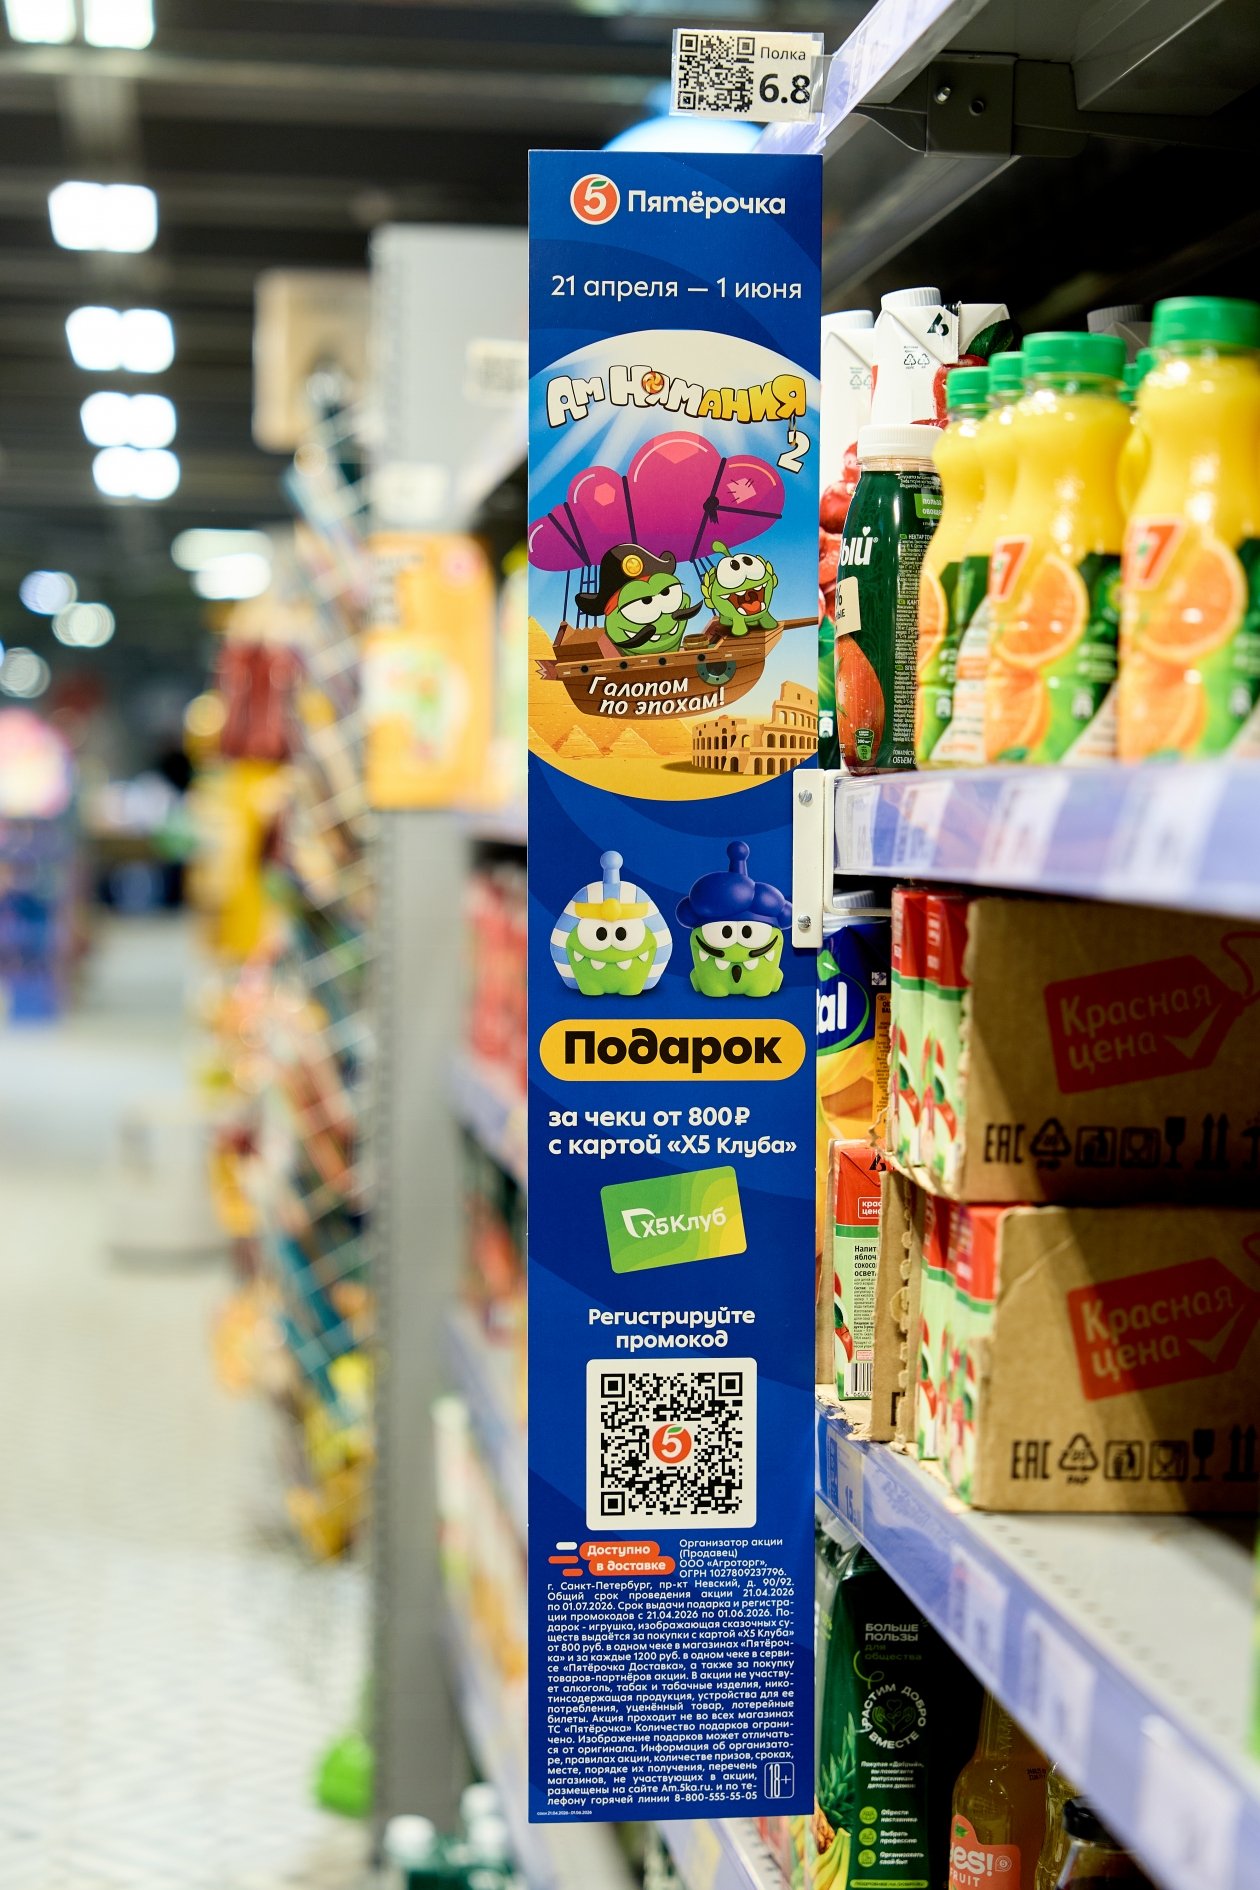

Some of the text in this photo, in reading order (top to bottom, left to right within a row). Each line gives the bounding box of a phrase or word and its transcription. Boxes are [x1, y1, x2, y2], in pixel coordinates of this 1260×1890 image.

[760, 46, 806, 62] Полка
[759, 73, 811, 105] 6.8
[628, 189, 786, 219] Пятёрочка
[551, 276, 575, 296] 21
[584, 277, 678, 301] апреля
[716, 277, 726, 298] 1
[734, 279, 802, 299] июня
[777, 429, 811, 475] 2
[589, 676, 688, 698] Галопом
[600, 687, 725, 715] по эпохам!
[1059, 983, 1213, 1038] Красная
[564, 1027, 782, 1074] Подарок
[1068, 1031, 1157, 1075] цена
[549, 1111, 578, 1127] за
[585, 1111, 646, 1127] чеки
[653, 1110, 682, 1126] от
[549, 1140, 561, 1155] с
[569, 1134, 661, 1159] картой
[717, 1136, 797, 1157] Клуба»
[984, 1123, 1026, 1163] EAC
[854, 1245, 877, 1253] Напит
[588, 1307, 755, 1328] Регистрируйте
[1081, 1285, 1234, 1345] Красная
[616, 1330, 728, 1352] промокод
[1091, 1335, 1181, 1382] цена
[1011, 1440, 1051, 1480] EAC
[587, 1545, 651, 1556] Доступно
[680, 1538, 783, 1549] Организатор акции
[680, 1548, 738, 1559] (Продавец)
[597, 1560, 666, 1572] в доставке
[680, 1558, 768, 1569] ООО «Агроторг»,
[680, 1567, 787, 1578] ОГРН 1027809237796.
[560, 1580, 652, 1592] Санкт-Петербург,
[659, 1581, 688, 1590] пр-кт
[694, 1578, 740, 1588] Невский,
[762, 1576, 794, 1587] 90/92.
[547, 1587, 794, 1601] Общий срок проведения акции 21.04.2026
[547, 1614, 566, 1622] ции
[570, 1613, 634, 1622] промокодов
[646, 1610, 698, 1619] 21.04.2026
[717, 1608, 772, 1617] 01.06.2026.
[776, 1608, 793, 1616] По-
[547, 1634, 579, 1642] ществ
[581, 1631, 630, 1642] выдаётся
[646, 1632, 689, 1641] покупки
[699, 1629, 735, 1640] картой
[757, 1627, 794, 1638] Клуба»
[865, 1623, 919, 1632] БОЛЬШЕ
[865, 1633, 918, 1642] ПОЛЬЗЫ
[563, 1662, 624, 1673] «Пятёрочка
[628, 1661, 685, 1671] Доставка»,
[701, 1661, 732, 1669] также
[753, 1660, 794, 1669] покупку
[562, 1684, 612, 1693] алкоголь,
[661, 1680, 712, 1690] табачные
[716, 1681, 761, 1690] изделия,
[900, 1686, 927, 1727] ДОБРО
[547, 1721, 793, 1735] ТС «Пятёрочка» Количество подарков ограни-
[577, 1745, 636, 1755] оригинала.
[641, 1742, 708, 1753] Информация
[712, 1740, 725, 1750] об
[728, 1741, 793, 1751] организато-
[868, 1730, 920, 1749] ВМЕСТЕ
[769, 1763, 791, 1798] 18+
[547, 1787, 609, 1796] размещены
[628, 1784, 658, 1793] сайте
[661, 1782, 712, 1792] Am.5ka.ru.
[547, 1795, 586, 1807] лефону
[590, 1795, 632, 1805] горячей
[674, 1791, 757, 1802] 8-800-555-55-05
